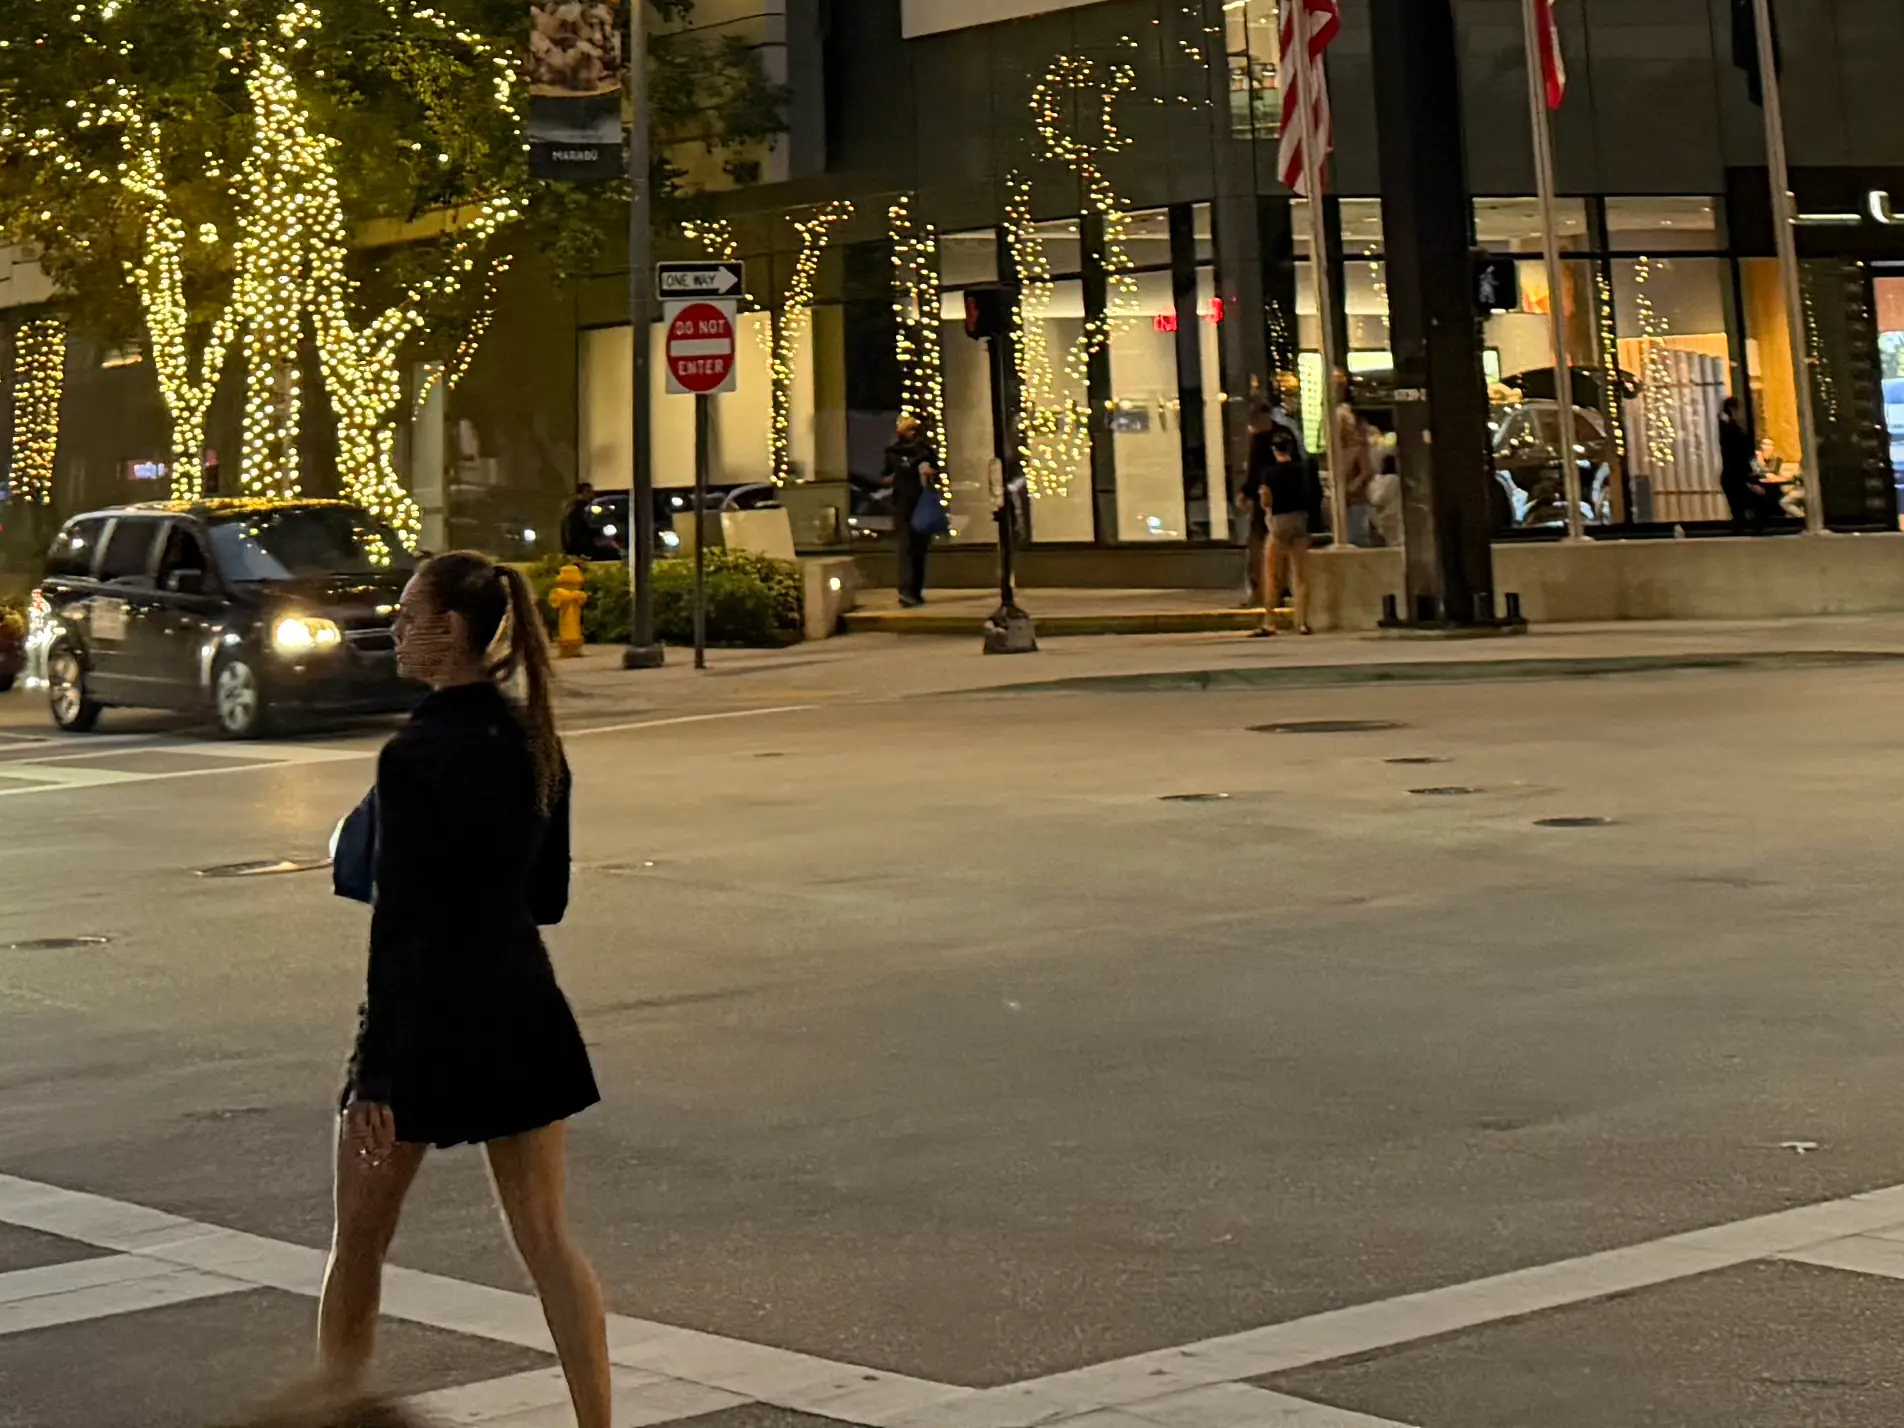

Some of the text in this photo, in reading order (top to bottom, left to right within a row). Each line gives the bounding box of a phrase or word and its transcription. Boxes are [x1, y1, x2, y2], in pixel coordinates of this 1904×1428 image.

[666, 272, 716, 287] ONE WAY
[675, 319, 726, 335] DO NOT
[677, 359, 724, 375] ENTER
